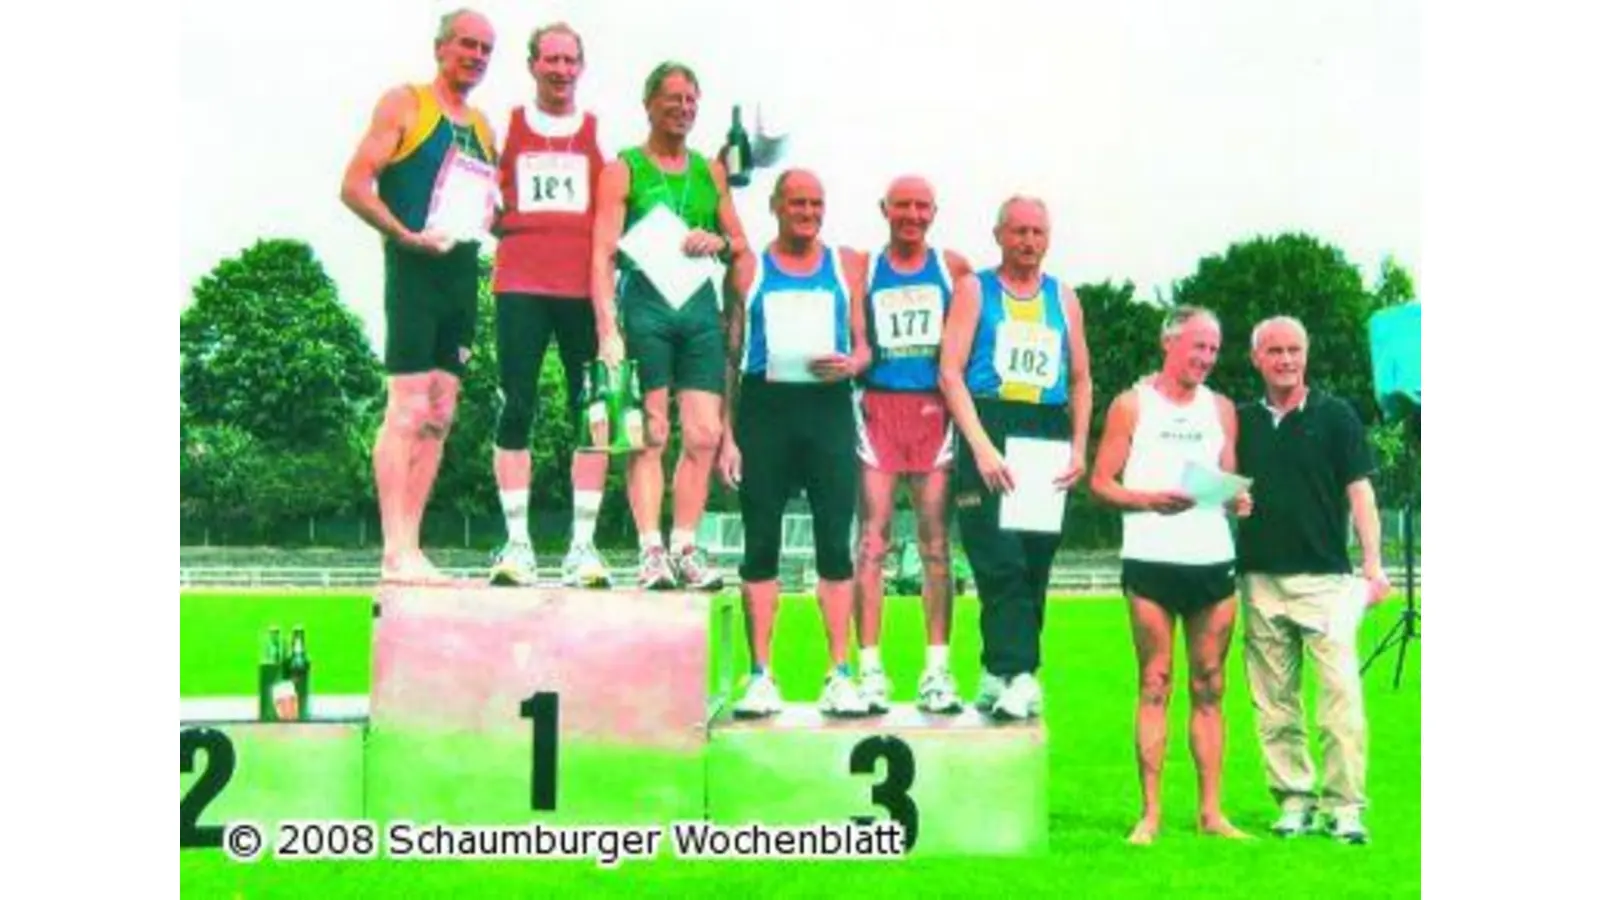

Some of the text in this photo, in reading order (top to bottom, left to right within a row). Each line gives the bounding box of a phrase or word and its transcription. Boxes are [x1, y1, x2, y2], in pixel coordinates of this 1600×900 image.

[889, 308, 932, 338] 177
[1008, 347, 1049, 377] 102
[180, 727, 236, 848] 2
[519, 692, 559, 811] 1
[849, 736, 919, 854] 3
